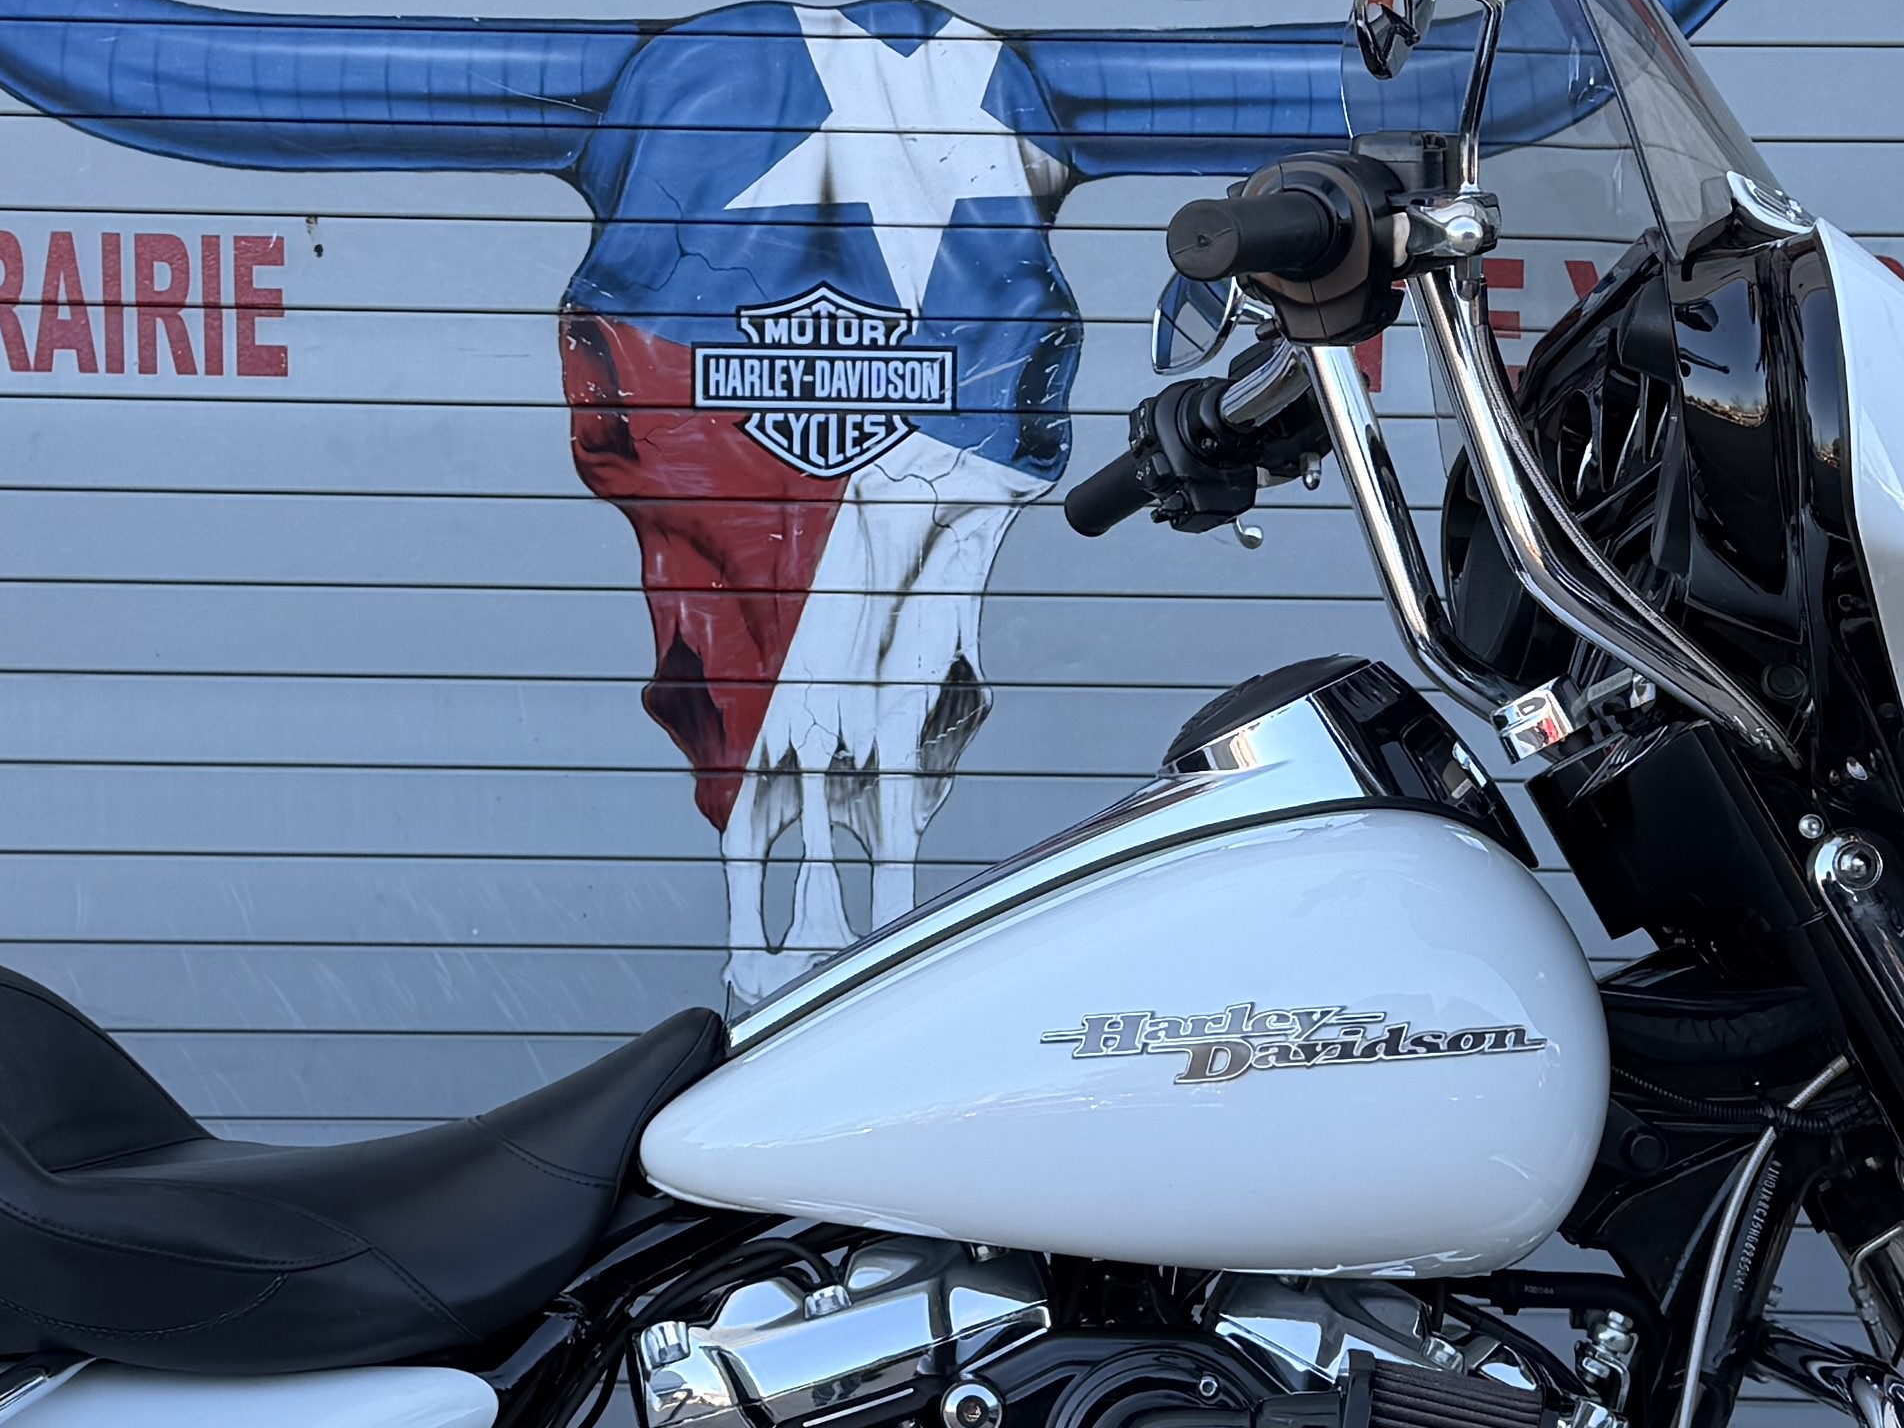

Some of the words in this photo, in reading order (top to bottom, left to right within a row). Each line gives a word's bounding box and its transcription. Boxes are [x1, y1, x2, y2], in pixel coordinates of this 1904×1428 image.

[764, 300, 887, 346] MOTOR
[708, 358, 941, 401] HARLEY-DAVIDSON
[764, 412, 889, 466] CYCLES
[1042, 1002, 1385, 1059] Harley
[1173, 1022, 1546, 1085] Davidson
